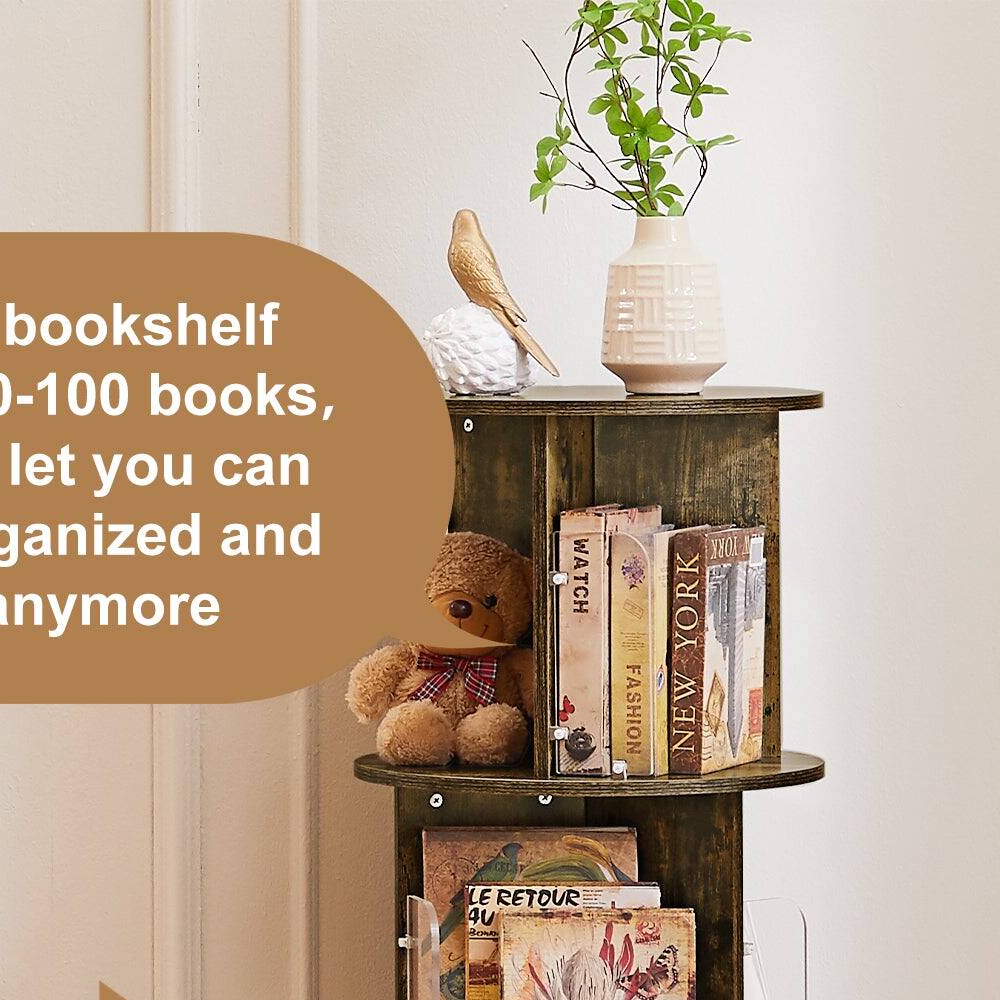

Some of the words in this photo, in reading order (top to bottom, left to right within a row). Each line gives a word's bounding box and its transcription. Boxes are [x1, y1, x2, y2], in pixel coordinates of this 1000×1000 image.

[572, 538, 590, 615] WATCH
[710, 536, 738, 560] YORK
[676, 552, 701, 653] YORK
[626, 664, 642, 755] FASHION
[673, 672, 699, 753] NEW
[469, 888, 492, 905] LE
[497, 889, 581, 908] RETOUR
[469, 907, 495, 926] AU
